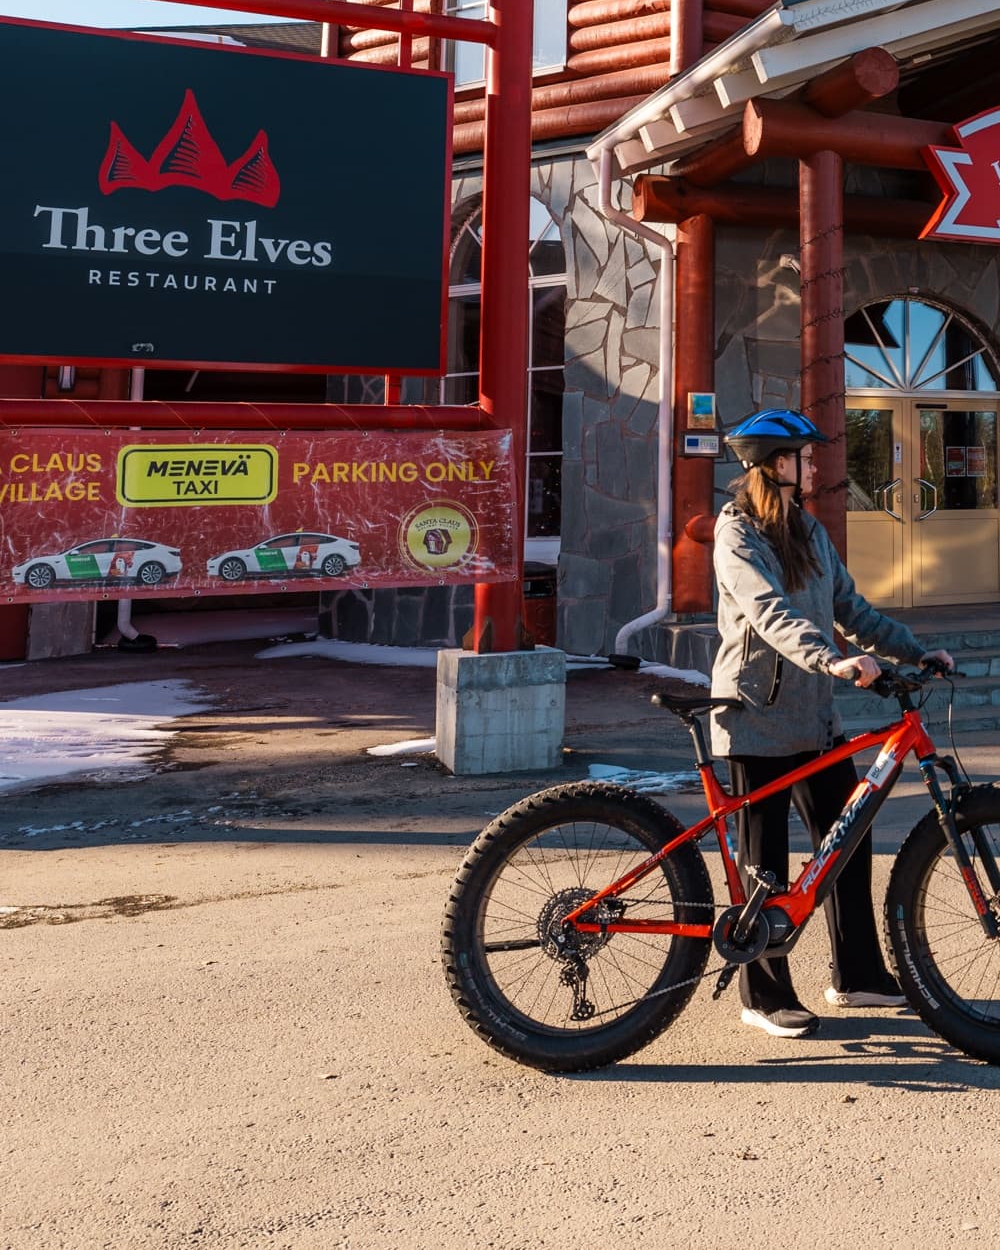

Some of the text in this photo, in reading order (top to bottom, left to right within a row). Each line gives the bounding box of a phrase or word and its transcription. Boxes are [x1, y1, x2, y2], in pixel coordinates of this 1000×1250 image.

[33, 204, 333, 267] Three Elves
[88, 269, 278, 295] RESTAURANT
[10, 453, 101, 473] CLAUS
[147, 454, 251, 478] MENEVÄ
[292, 460, 495, 484] PARKING ONLY
[172, 480, 219, 496] TAXI
